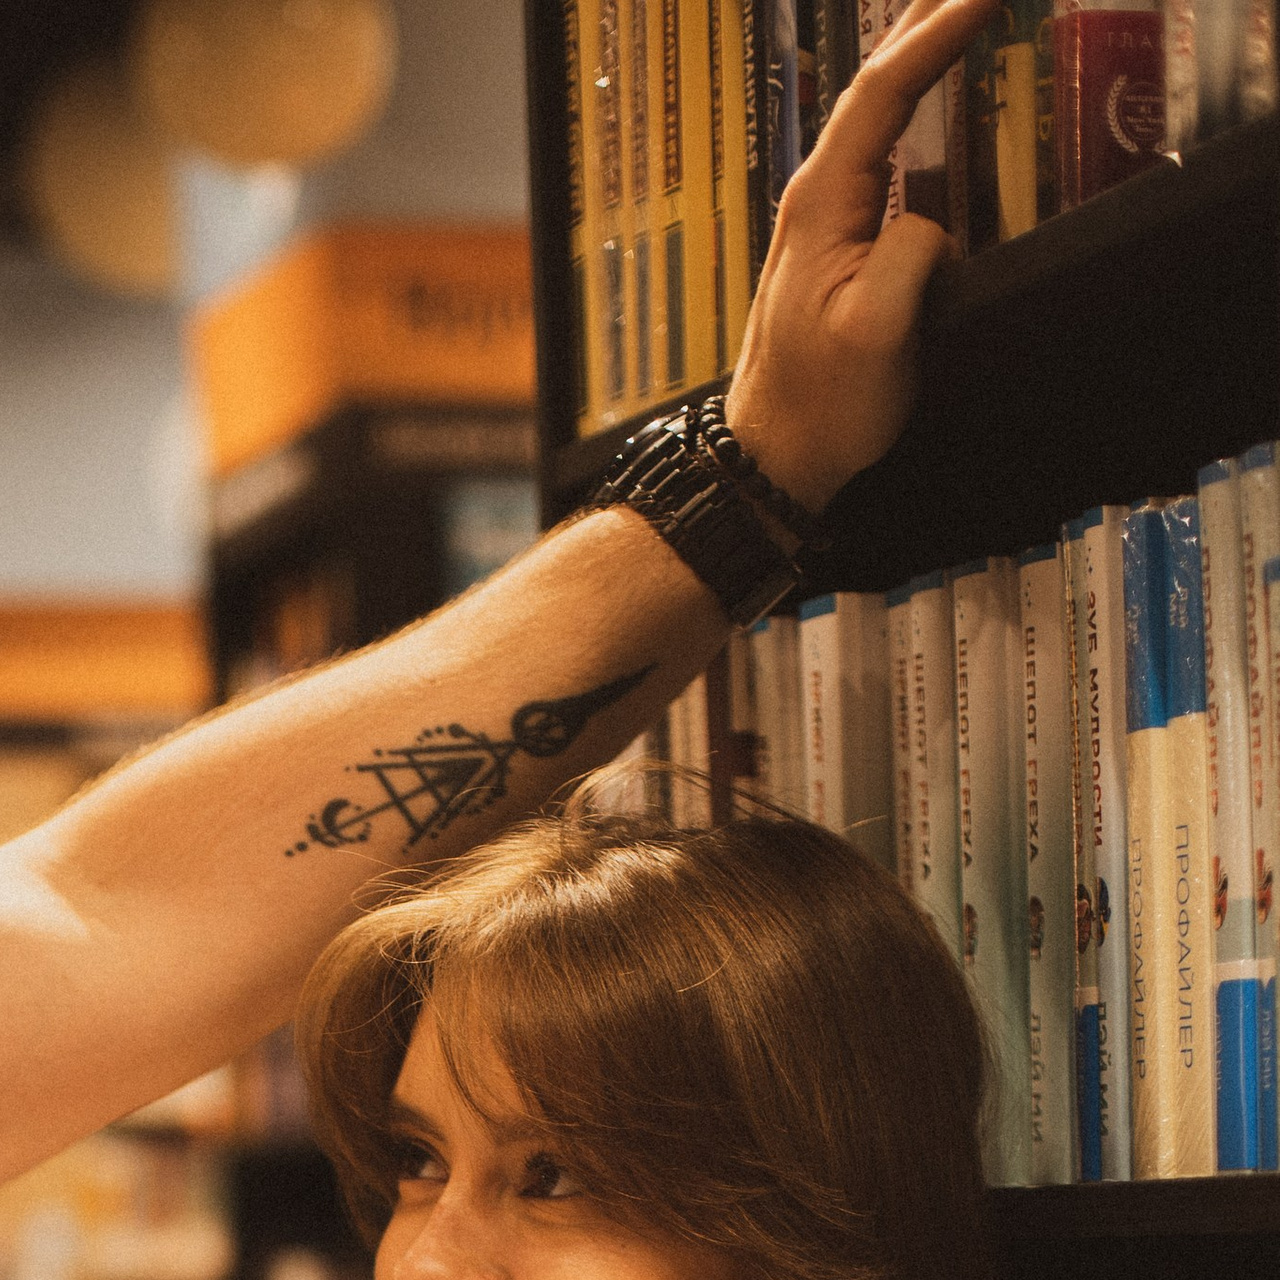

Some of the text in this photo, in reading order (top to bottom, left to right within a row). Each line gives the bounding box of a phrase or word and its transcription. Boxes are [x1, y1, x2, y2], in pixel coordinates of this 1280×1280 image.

[1086, 591, 1098, 650] ЗУБ
[1243, 532, 1264, 810] ПРОФАЙЛЕР
[914, 652, 931, 882] ШЕПОТ ГРЕХА
[958, 637, 972, 870] ШЕПОТ ГРЕХА
[1025, 625, 1039, 864] ШЕПОТ ГРЕХА
[1131, 838, 1147, 1080] ПРОФАЙЛЕР
[1175, 824, 1195, 1071] ПРОФАЙЛЕР
